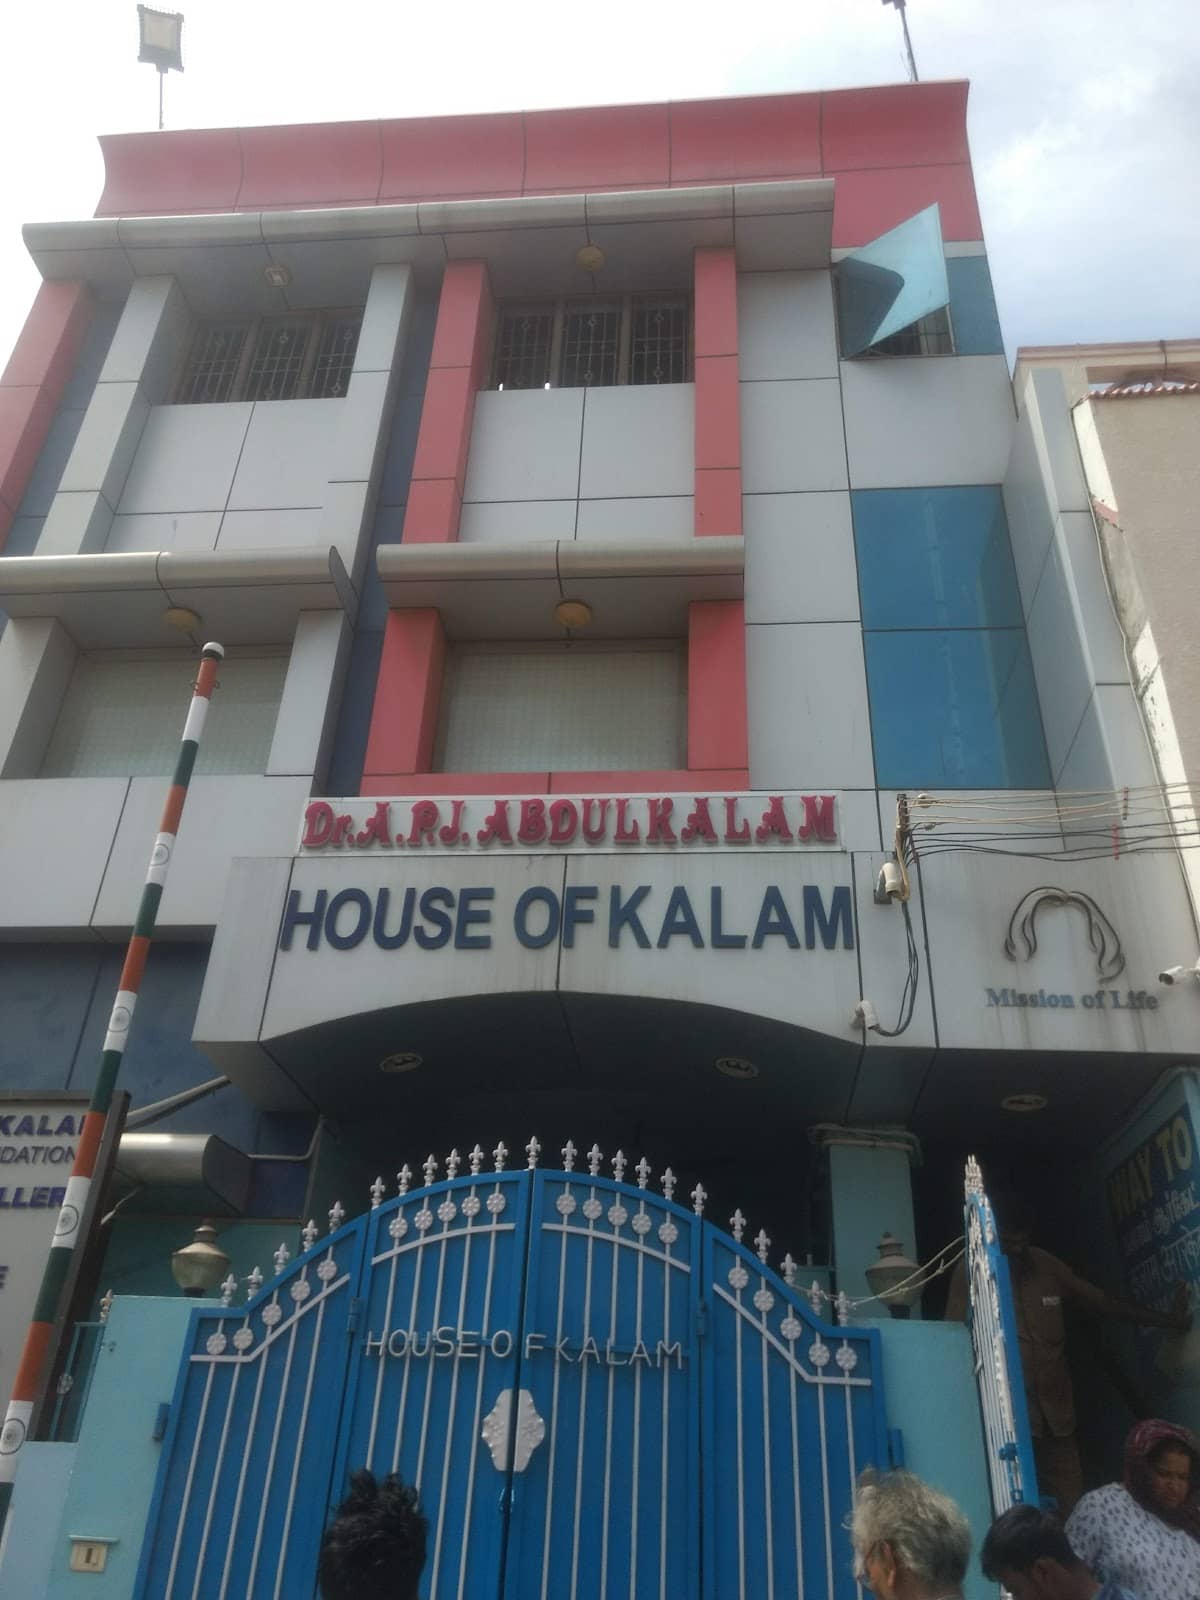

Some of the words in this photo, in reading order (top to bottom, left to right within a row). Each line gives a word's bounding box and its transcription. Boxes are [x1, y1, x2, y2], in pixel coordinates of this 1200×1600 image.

[280, 886, 495, 951] HOUSE
[514, 885, 598, 950] OF
[608, 885, 854, 950] KALAM
[985, 988, 1075, 1008] Mission
[1082, 989, 1105, 1009] of
[1109, 989, 1158, 1010] Life
[1156, 1114, 1193, 1183] TO
[365, 1326, 480, 1358] HOUSE
[555, 1336, 684, 1370] KALAM
